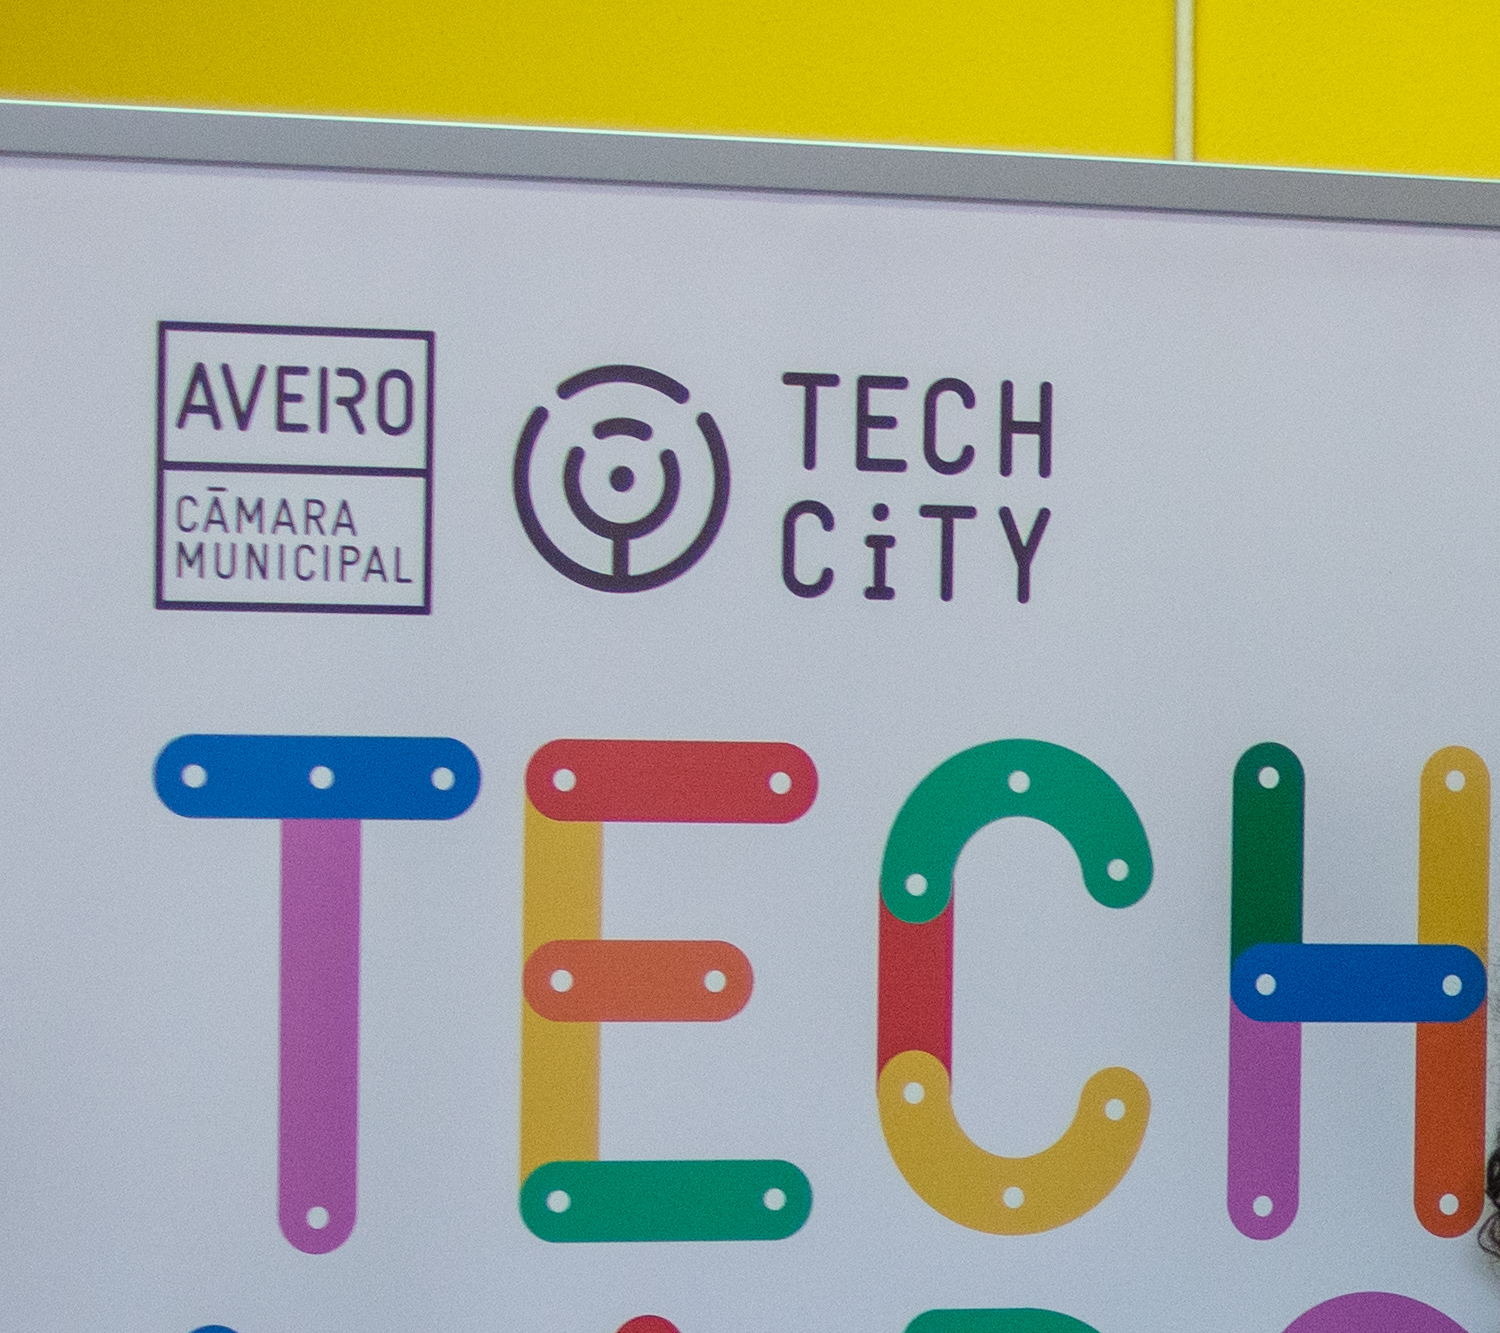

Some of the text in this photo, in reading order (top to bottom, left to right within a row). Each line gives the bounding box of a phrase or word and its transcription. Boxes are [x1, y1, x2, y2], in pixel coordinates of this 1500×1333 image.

[175, 362, 416, 437] AVEIRO
[780, 371, 1055, 480] TECH
[175, 541, 416, 587] MUNICIPAL
[152, 733, 1492, 1255] TECH
